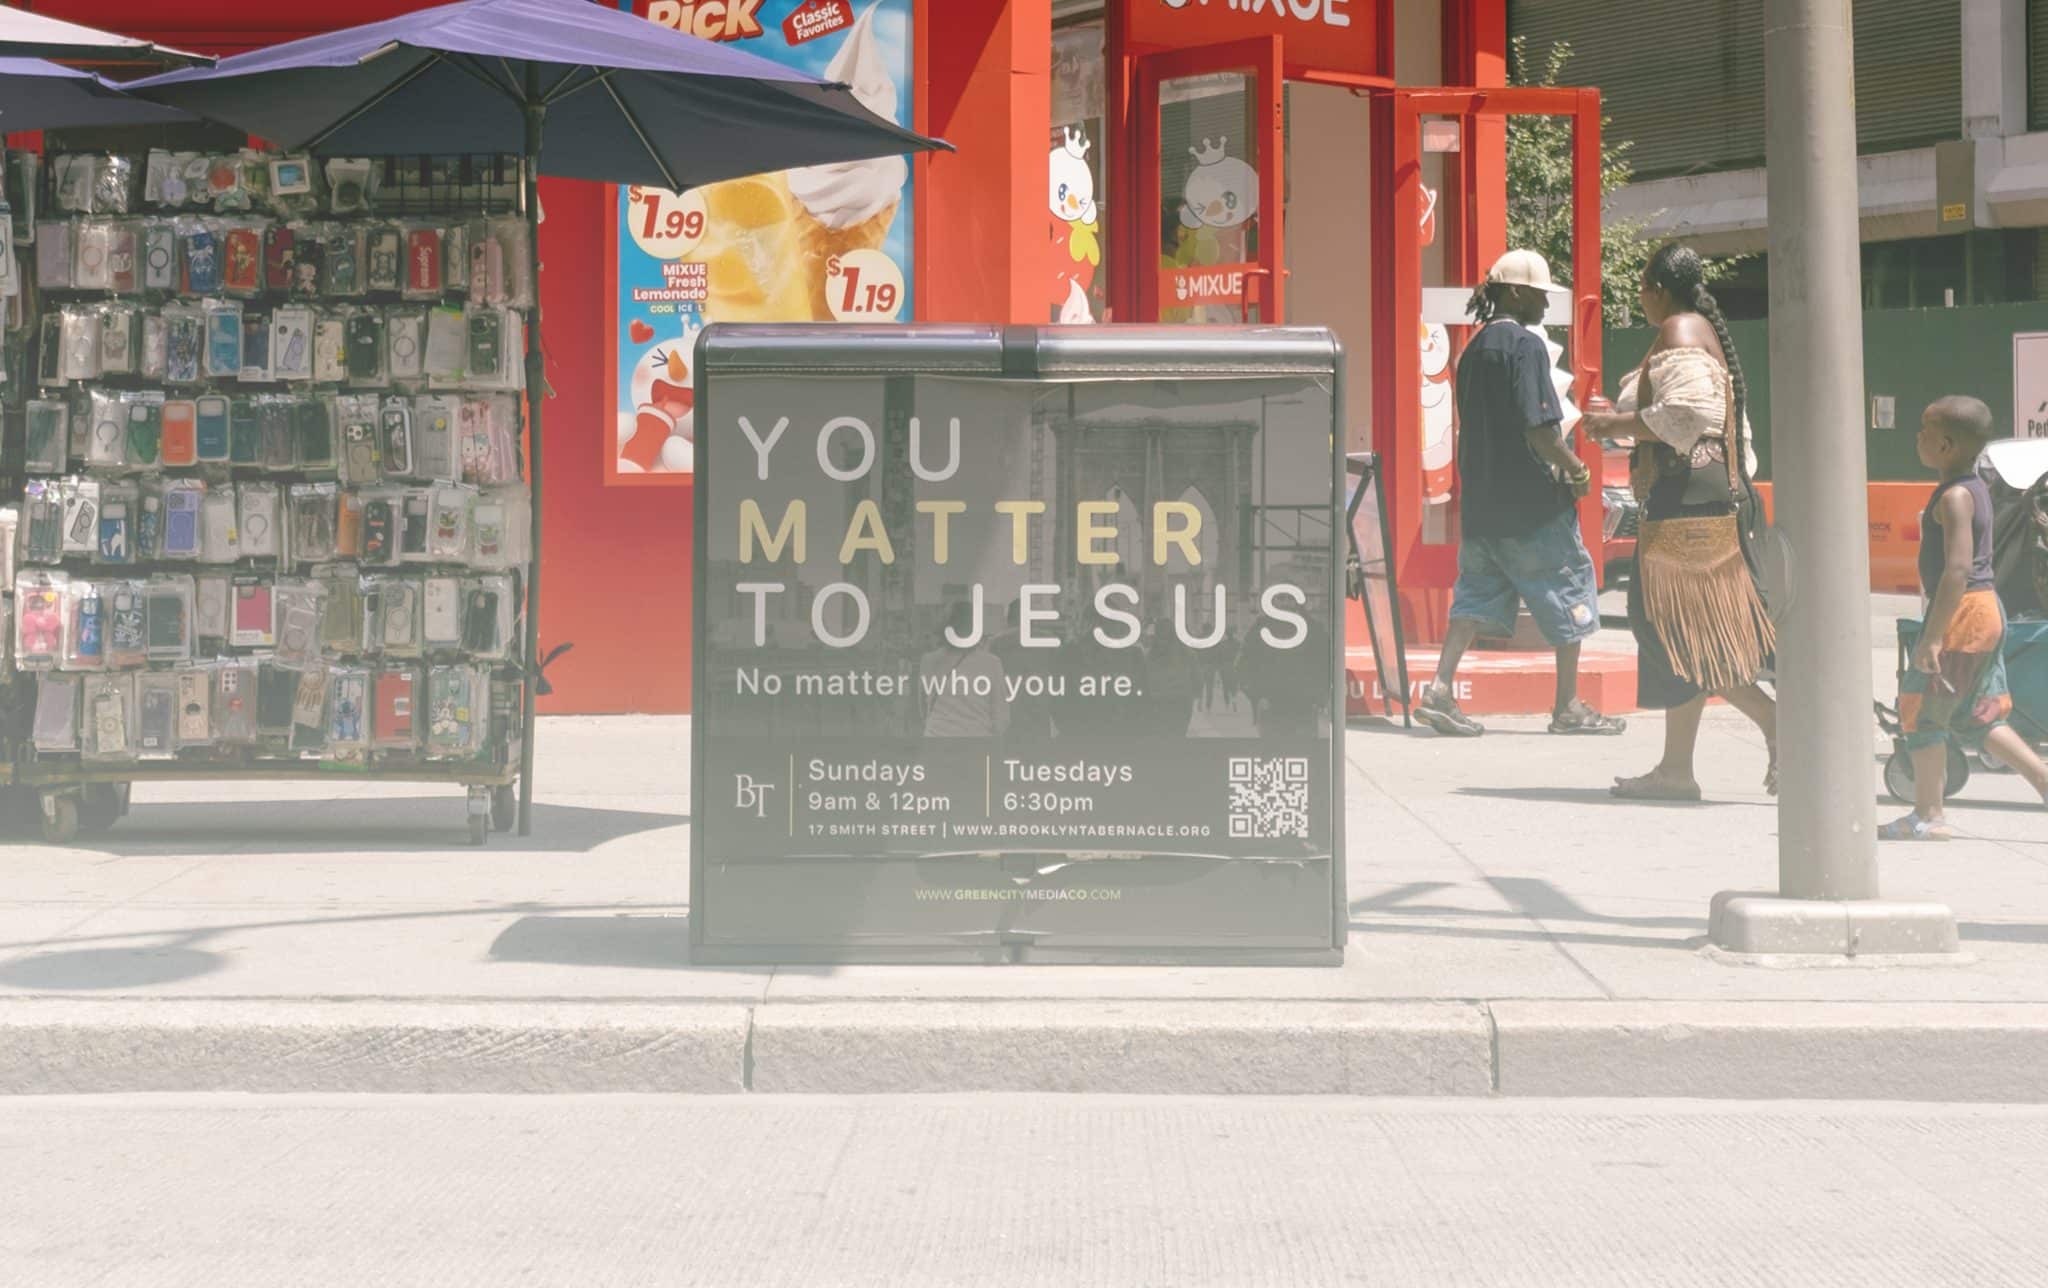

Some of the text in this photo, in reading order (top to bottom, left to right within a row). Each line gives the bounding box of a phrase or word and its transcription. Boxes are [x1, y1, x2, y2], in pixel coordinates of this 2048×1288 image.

[793, 2, 840, 29] Classic
[797, 15, 844, 40] Favorites
[663, 264, 706, 276] MIXUE
[668, 277, 706, 288] Fresh
[634, 288, 707, 301] Lemonade
[1189, 272, 1243, 297] MIXUE
[738, 416, 961, 482] YOU
[738, 499, 1204, 566] MATTER
[736, 582, 1309, 648] TO JESUS
[737, 667, 1143, 702] No matter who you are.
[809, 759, 926, 786] Sundays
[1004, 760, 1133, 787] Tuesdays
[735, 774, 775, 817] BT
[809, 792, 950, 814] 9am & 12pm
[1004, 793, 1093, 814] 6:30pm
[808, 824, 1211, 837] 17 SMITH STREET WWW.BROOKLYNTABERNACLE.ORG
[915, 888, 1122, 901] WWW.GREENCITYMEDIACO.COM
